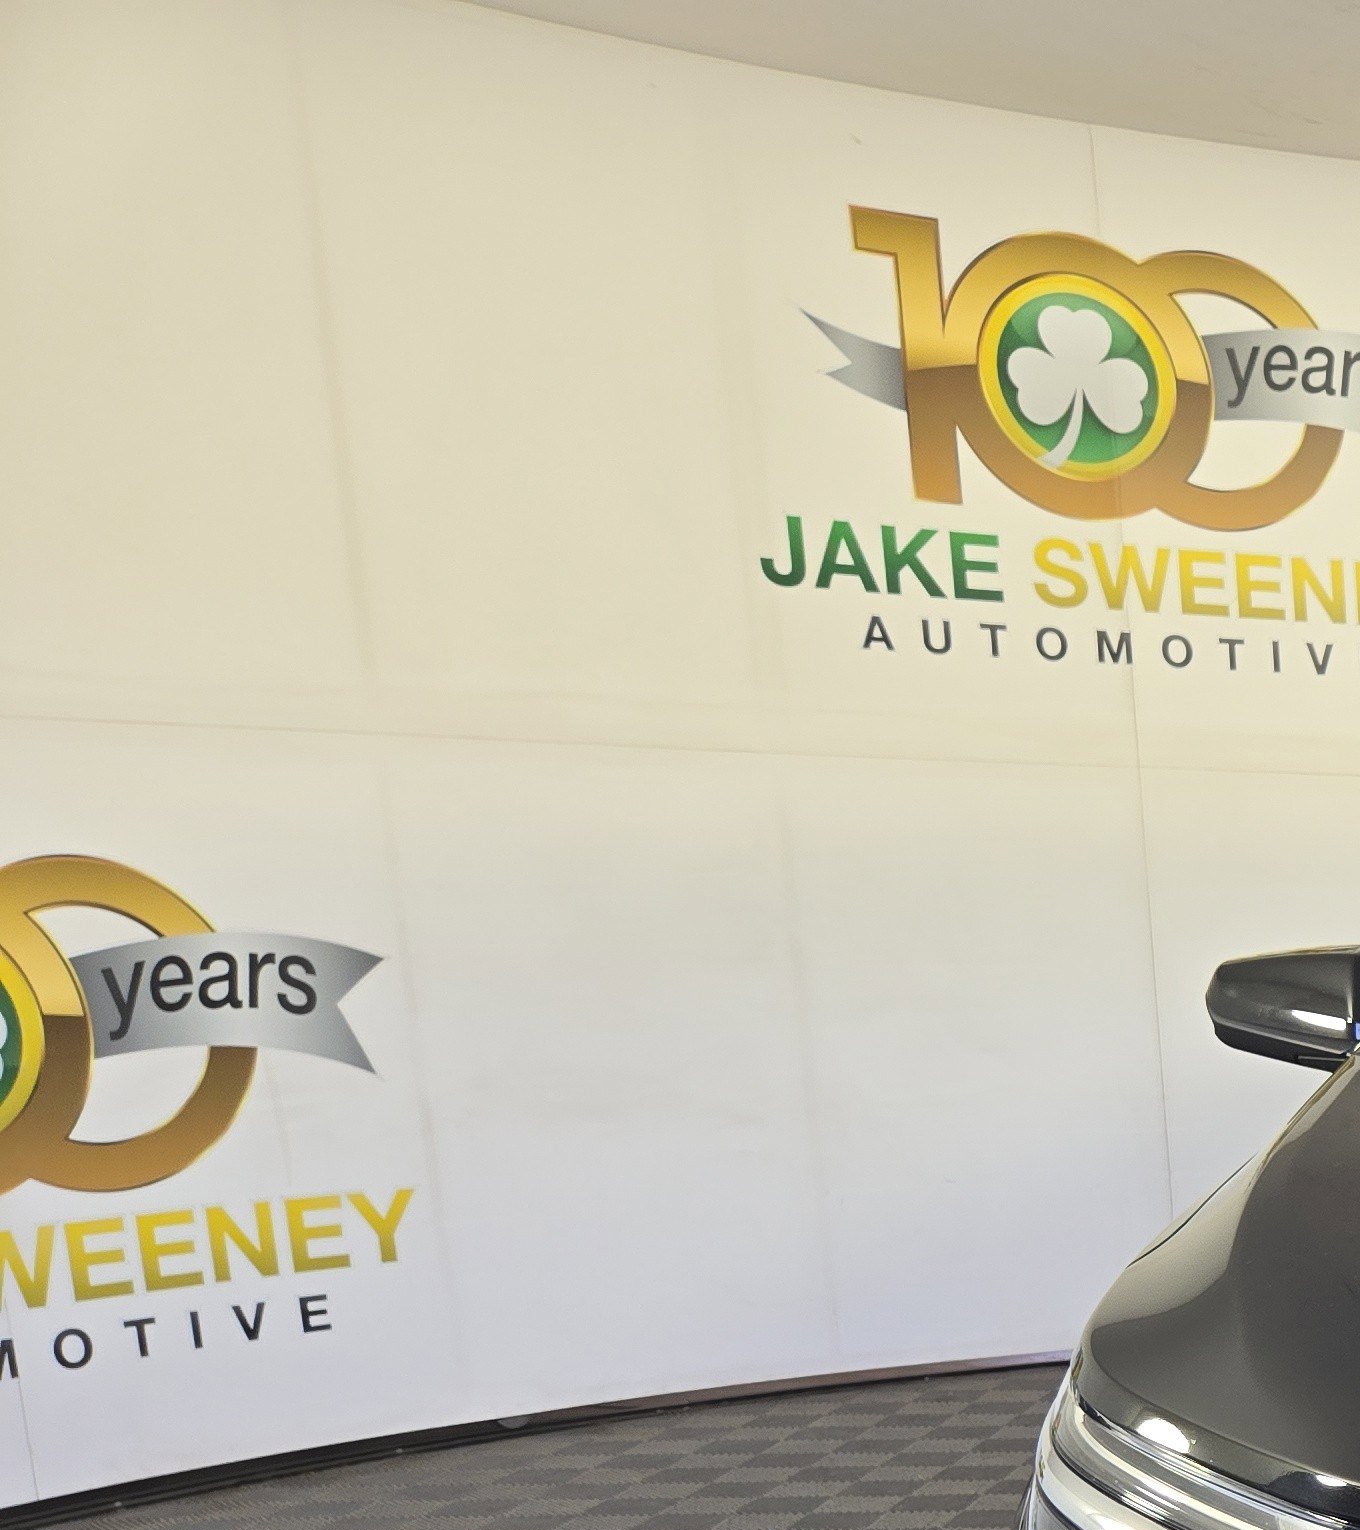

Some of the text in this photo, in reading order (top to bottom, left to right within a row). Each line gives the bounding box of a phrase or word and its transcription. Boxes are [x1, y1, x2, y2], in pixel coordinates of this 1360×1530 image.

[848, 204, 1345, 532] 100
[760, 515, 1004, 602] JAKE
[101, 951, 318, 1041] years
